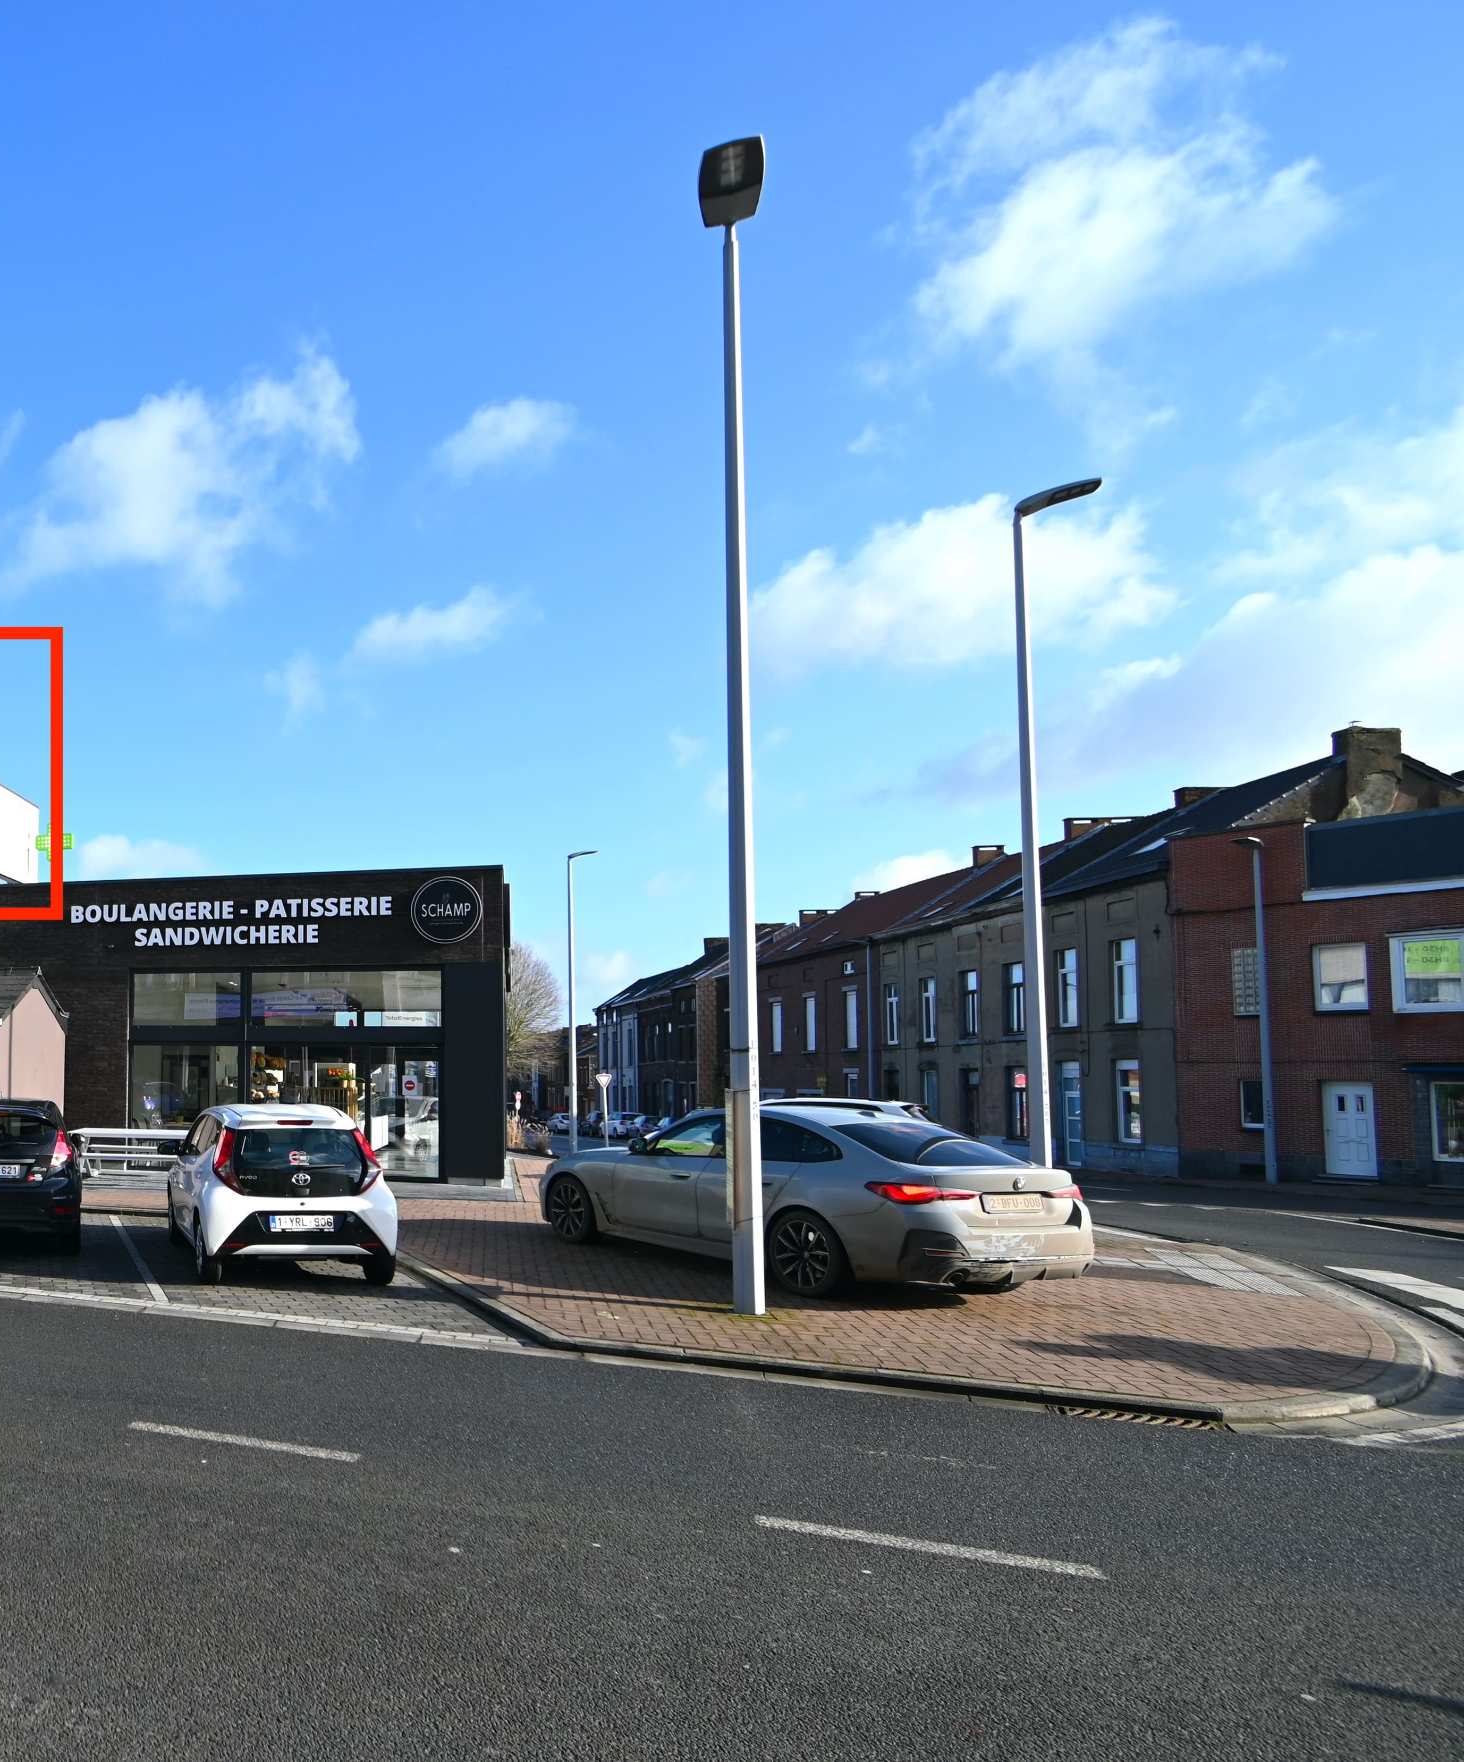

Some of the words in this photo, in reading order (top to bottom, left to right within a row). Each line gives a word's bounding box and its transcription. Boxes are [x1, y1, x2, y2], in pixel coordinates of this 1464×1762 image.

[70, 900, 234, 924] BOULANGERIE
[254, 896, 393, 919] PATISSERIE
[421, 902, 471, 918] SCHAMP
[134, 924, 320, 947] SANDWICHERIE
